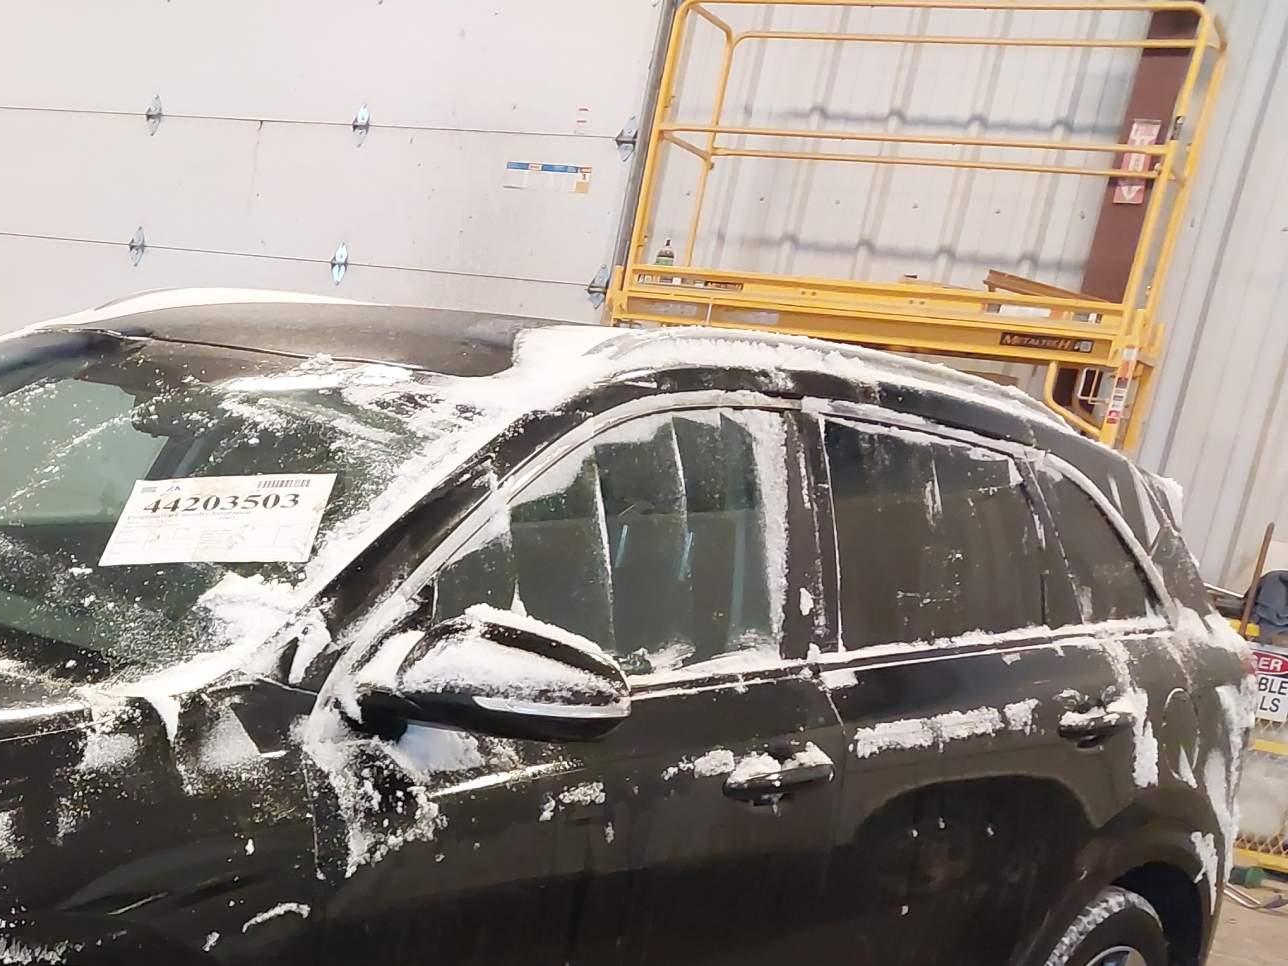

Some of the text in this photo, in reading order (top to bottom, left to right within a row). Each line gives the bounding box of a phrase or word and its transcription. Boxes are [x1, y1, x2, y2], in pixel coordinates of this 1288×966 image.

[143, 493, 300, 513] 44203503
[1257, 657, 1283, 672] ER
[1258, 677, 1288, 695] BLE
[1259, 696, 1281, 713] LS
